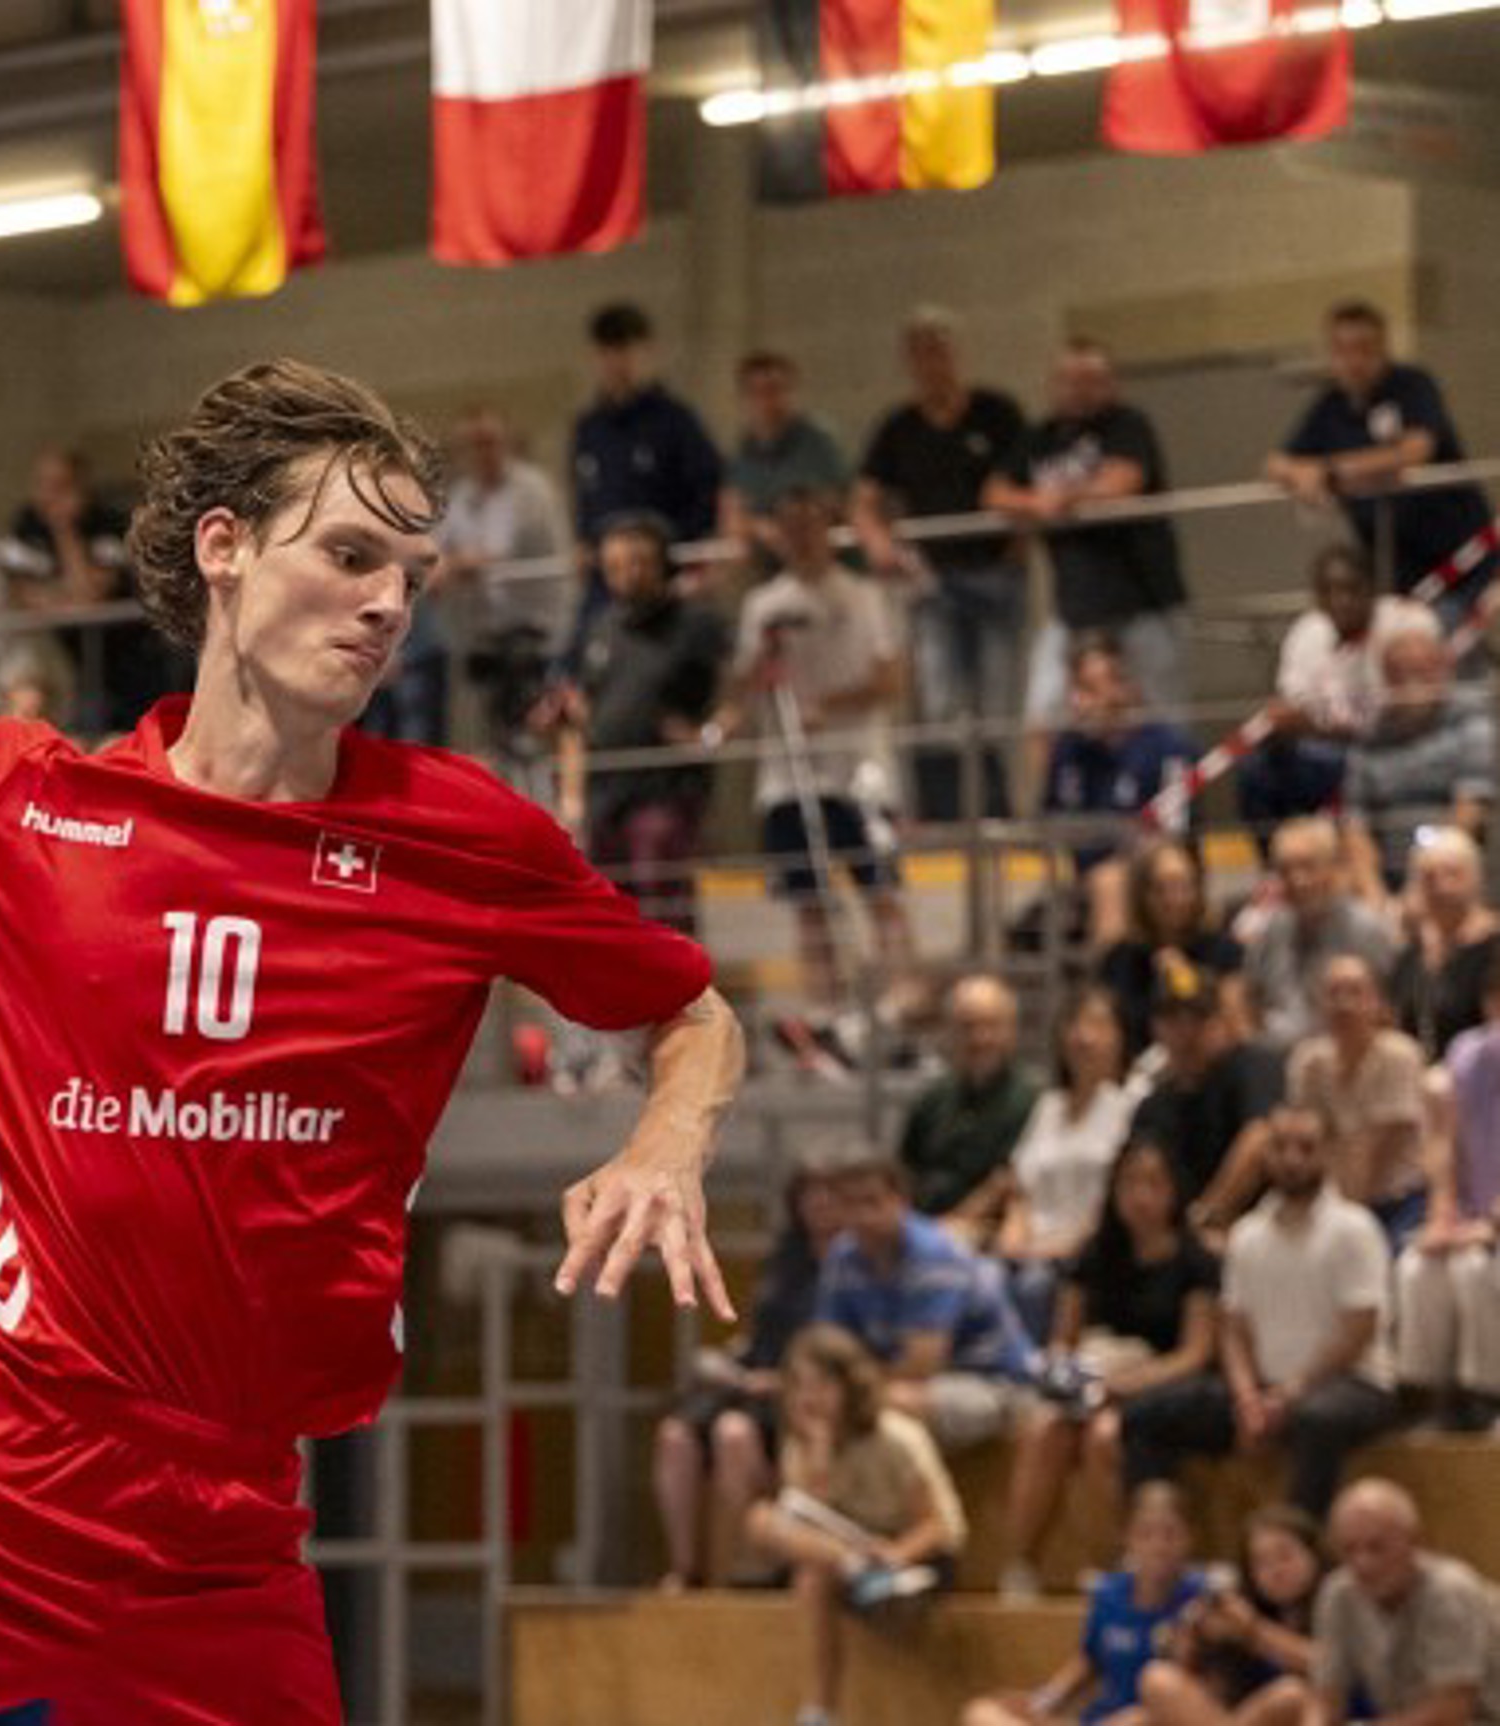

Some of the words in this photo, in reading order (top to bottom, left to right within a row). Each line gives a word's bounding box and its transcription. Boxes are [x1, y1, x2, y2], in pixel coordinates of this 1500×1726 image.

[21, 801, 134, 847] hummel
[163, 911, 262, 1040] 10
[48, 1077, 122, 1134] die
[128, 1087, 344, 1142] Mobiliar
